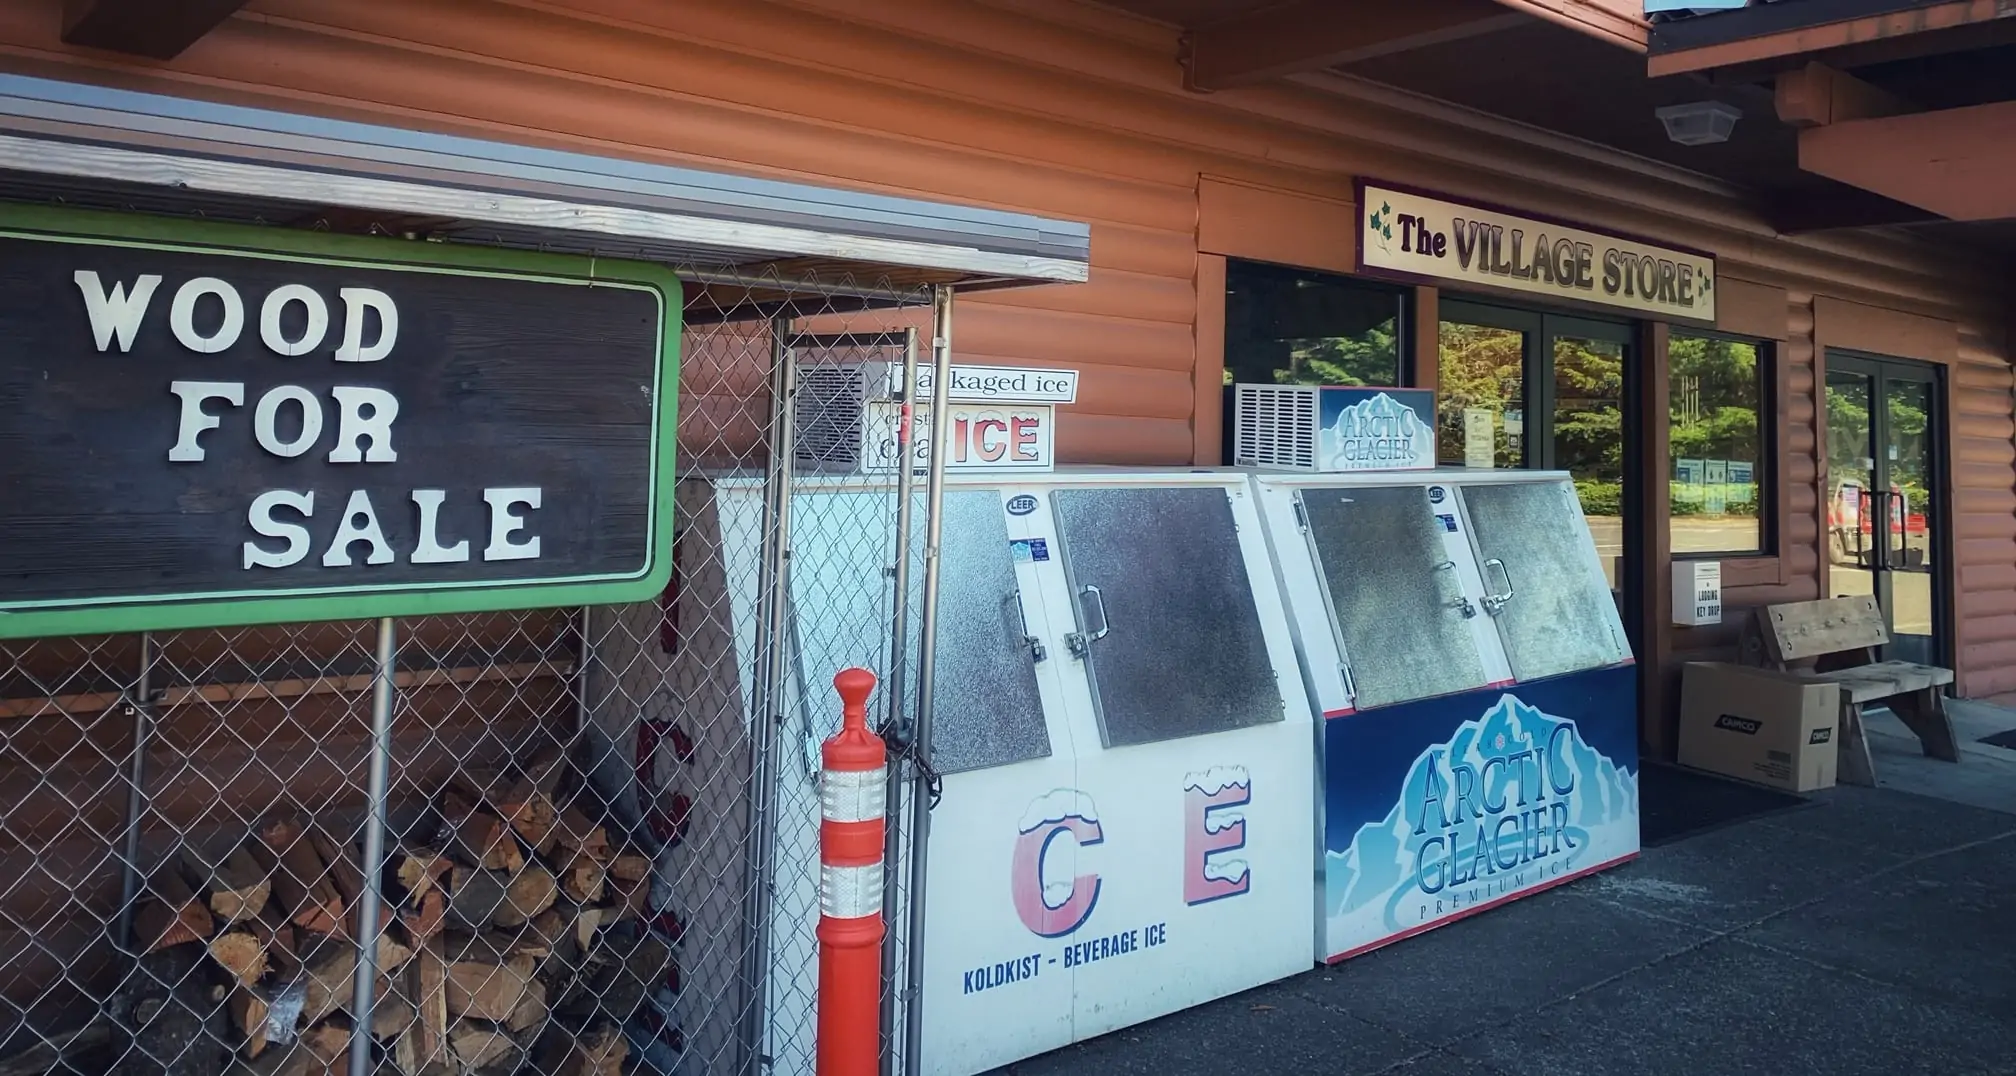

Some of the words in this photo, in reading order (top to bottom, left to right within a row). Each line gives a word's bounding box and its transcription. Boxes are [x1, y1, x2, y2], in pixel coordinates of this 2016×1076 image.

[1397, 213, 1447, 258] The
[1453, 217, 1594, 291] VILLAGE
[1602, 248, 1695, 308] STORE
[74, 270, 399, 363] WOOD
[901, 370, 1026, 395] akaged
[1036, 376, 1069, 393] ice
[168, 381, 400, 463] FOR
[953, 409, 1040, 463] ICE
[1343, 408, 1415, 438] ARCTIC
[1343, 439, 1414, 461] GLACIER
[243, 487, 542, 570] SALE
[1010, 499, 1035, 510] LEER
[1696, 606, 1706, 618] KEY
[1707, 605, 1720, 617] DROP
[1698, 589, 1718, 602] LODGING
[1721, 715, 1756, 732] CAMCO
[1414, 722, 1576, 836] ARCTIC
[1415, 801, 1577, 895] GLACIER
[1420, 873, 1525, 920] PREMIUM
[1539, 856, 1573, 879] ICE
[963, 953, 1042, 995] KOLDKIST
[1063, 929, 1138, 969] BEVERAGE
[1144, 922, 1167, 948] ICE
